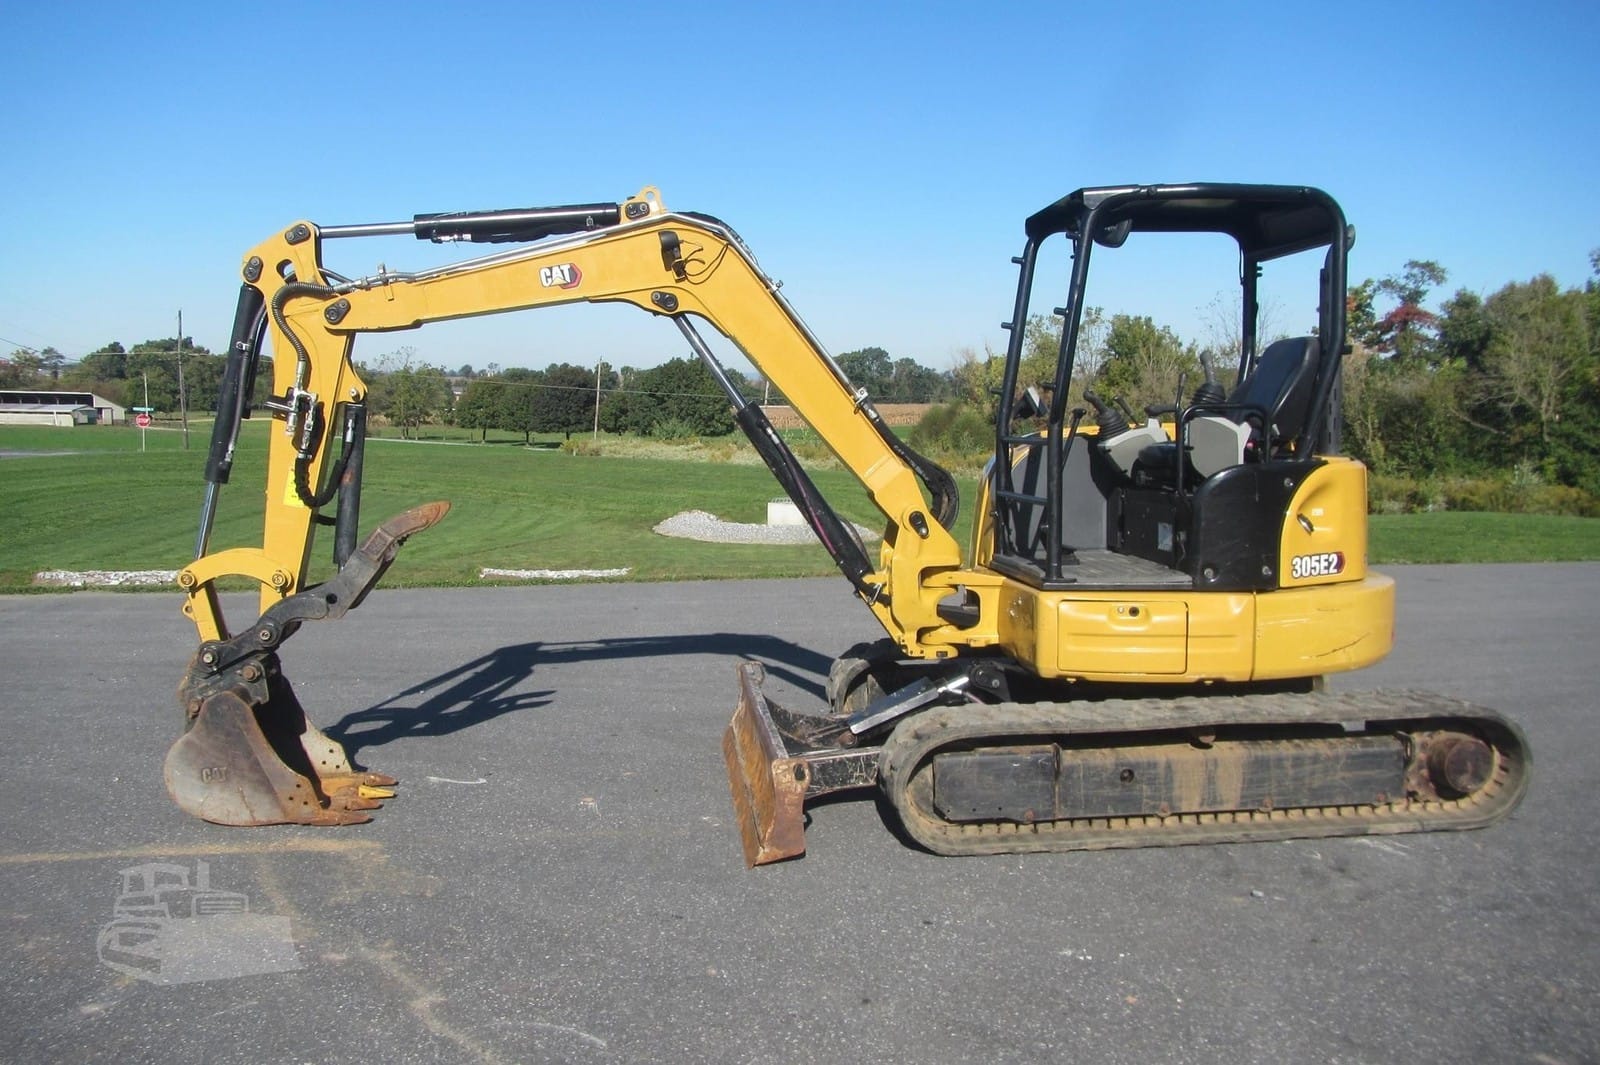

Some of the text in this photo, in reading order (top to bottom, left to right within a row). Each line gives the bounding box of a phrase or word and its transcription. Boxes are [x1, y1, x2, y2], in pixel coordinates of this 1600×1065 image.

[540, 263, 571, 287] CAT
[1292, 553, 1338, 578] 305E2
[201, 767, 227, 784] CAT
